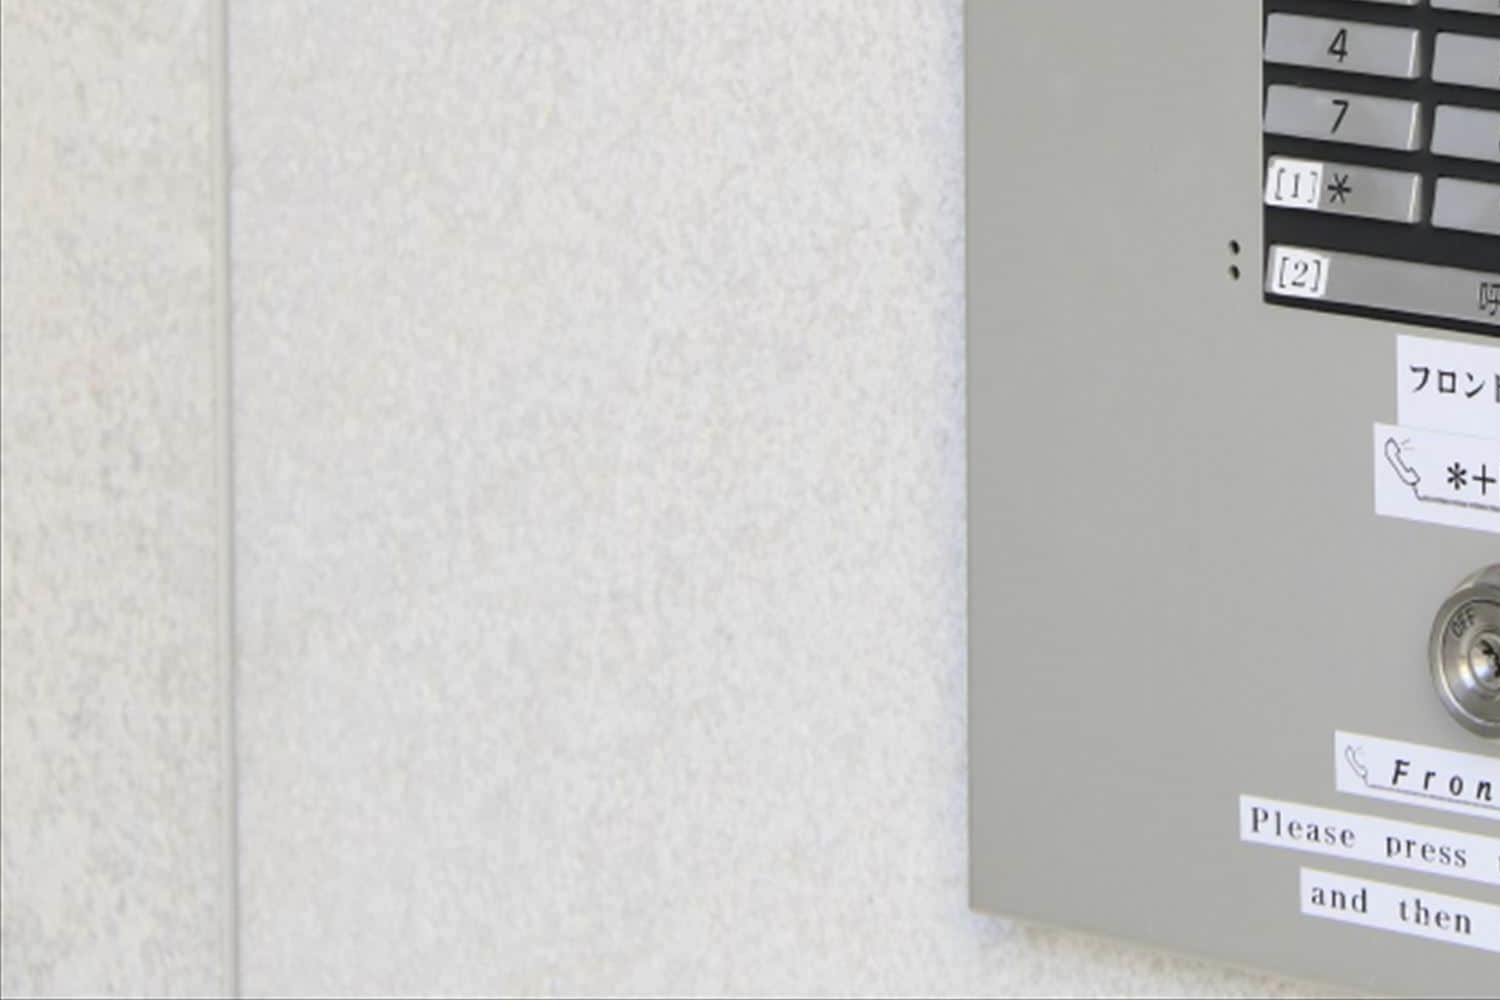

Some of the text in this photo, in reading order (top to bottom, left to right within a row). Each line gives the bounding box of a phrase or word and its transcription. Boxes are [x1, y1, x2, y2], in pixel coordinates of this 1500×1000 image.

[1327, 28, 1349, 63] 4
[1330, 99, 1350, 135] 7
[1273, 168, 1320, 201] [1]
[1277, 256, 1324, 293] [2]
[1450, 607, 1476, 638] OFF
[1250, 806, 1356, 849] Please
[1385, 834, 1469, 868] press
[1310, 882, 1369, 915] and
[1398, 899, 1473, 936] then
